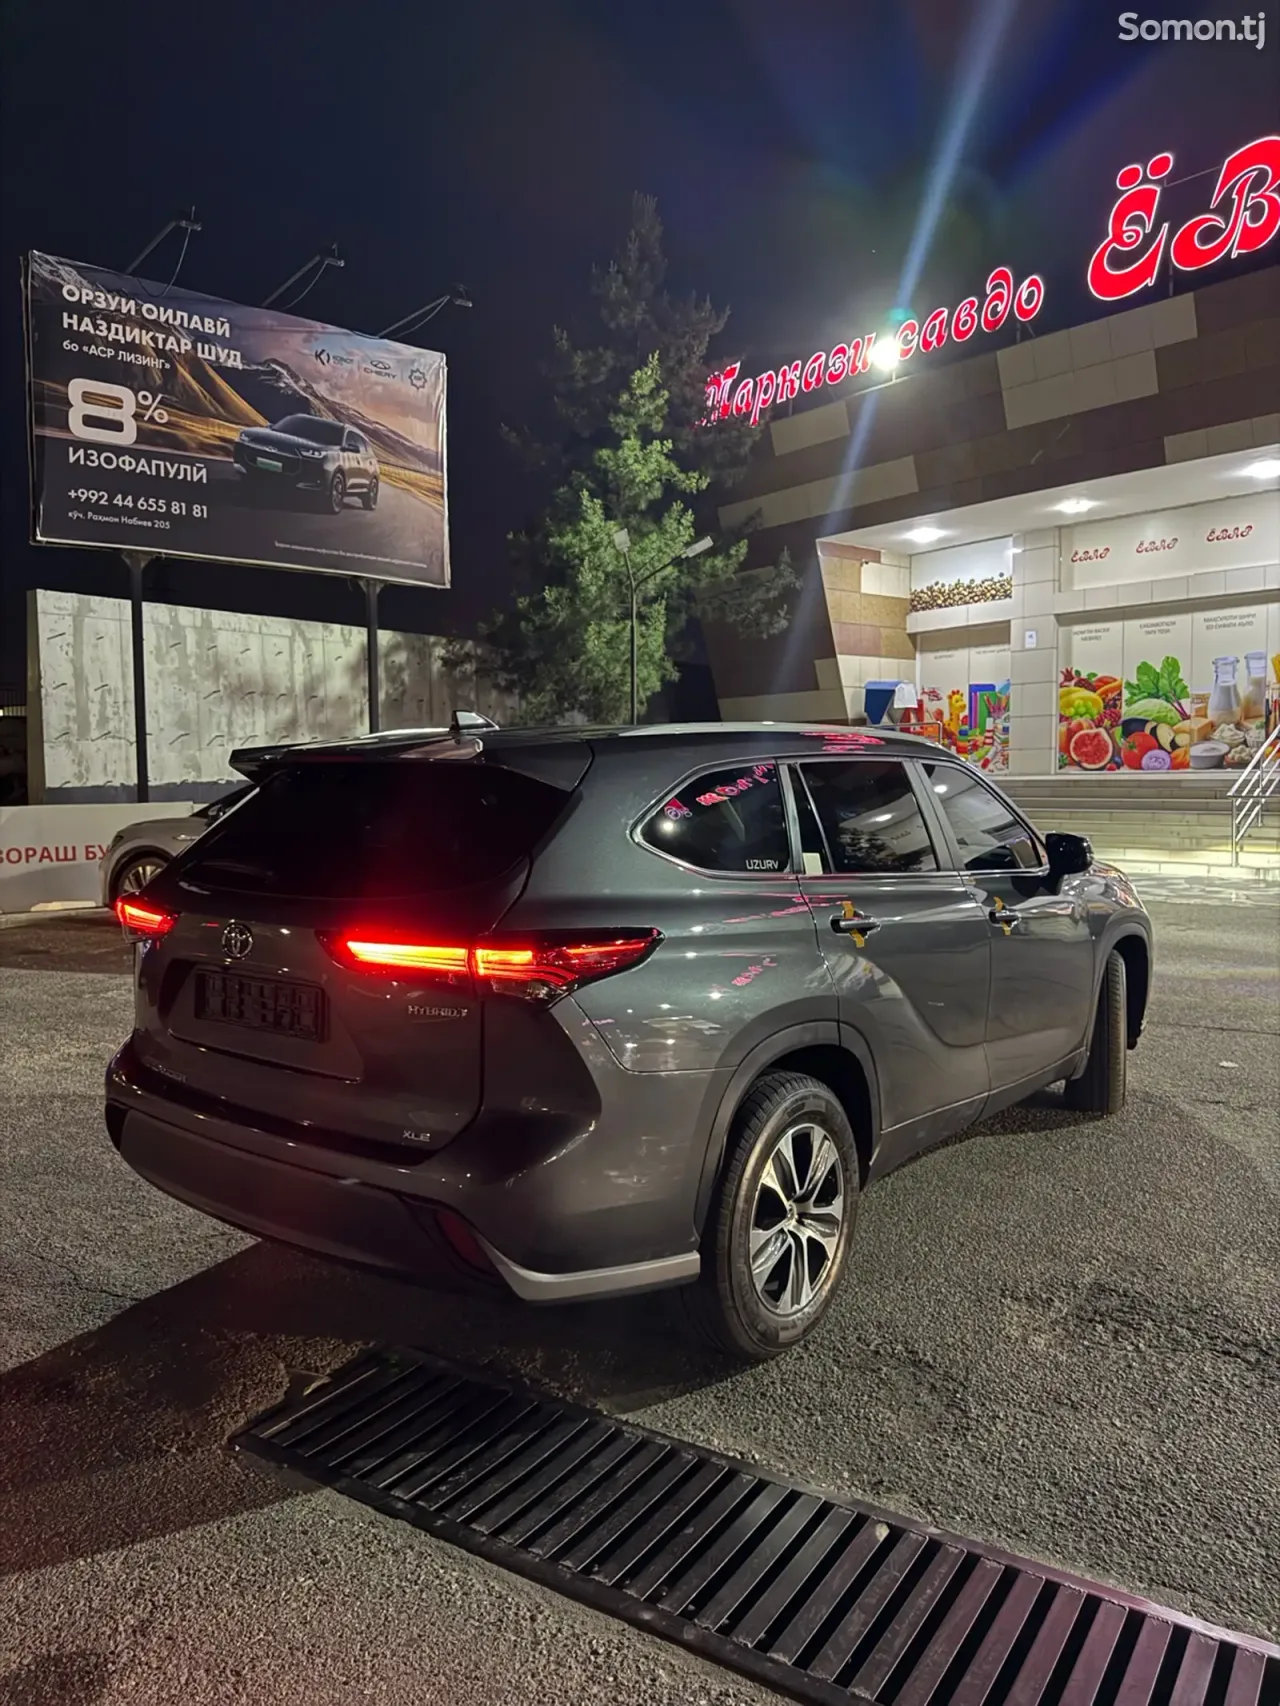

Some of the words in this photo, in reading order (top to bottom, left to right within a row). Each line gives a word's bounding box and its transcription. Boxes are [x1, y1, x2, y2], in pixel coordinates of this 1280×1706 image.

[62, 284, 136, 316] ОРЗУИ
[895, 266, 1044, 361] савдо
[62, 312, 192, 354] НАЗДИКТАР
[197, 342, 242, 370] ШУД
[62, 339, 79, 352] бо
[82, 344, 115, 359] «АСР
[117, 351, 171, 370] ЛИЗИНГ»
[363, 367, 397, 380] CHERY
[68, 488, 109, 505] +992
[112, 493, 134, 509] 44
[137, 497, 167, 513] 655
[170, 501, 187, 516] 81
[192, 504, 208, 519] 81
[153, 519, 170, 530] 205
[403, 1130, 431, 1142] XLE
